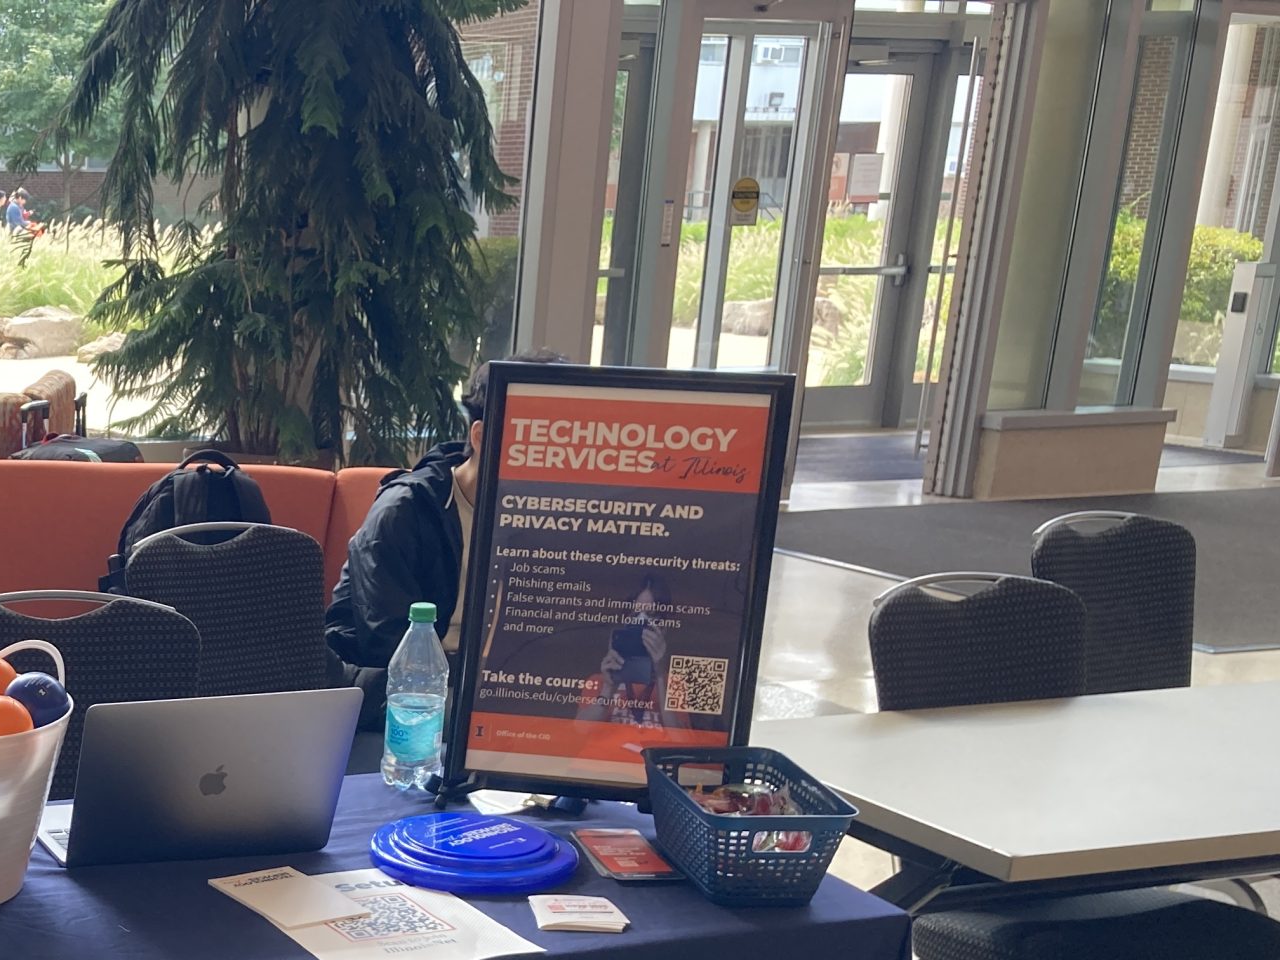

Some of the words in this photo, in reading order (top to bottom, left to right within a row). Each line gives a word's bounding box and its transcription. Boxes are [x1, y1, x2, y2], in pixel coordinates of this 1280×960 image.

[511, 417, 738, 452] TECHNOLOGY
[507, 444, 656, 474] SERVICES
[650, 456, 675, 473] at
[679, 456, 748, 484] Illinois
[501, 494, 657, 517] CYBERSECURITY
[660, 504, 704, 520] AND
[499, 513, 583, 531] PRIVACY
[587, 519, 670, 538] MATTER.
[496, 545, 529, 558] Learn
[532, 547, 567, 560] about
[570, 550, 603, 563] these
[606, 552, 689, 571] cybersecurity
[692, 558, 740, 572] threats:
[510, 562, 530, 573] Job
[532, 565, 566, 575] scams
[508, 576, 554, 592] Phishing
[556, 580, 591, 592] emails
[506, 591, 534, 604] False
[536, 595, 582, 607] warrants
[584, 597, 605, 608] and
[607, 598, 674, 613] immigration
[675, 604, 711, 616] scams
[503, 622, 524, 632] and
[526, 624, 554, 634] more
[505, 606, 553, 619] Financial
[555, 610, 575, 620] and
[577, 612, 619, 624] student
[621, 614, 645, 625] loan
[647, 618, 681, 629] scams
[481, 669, 515, 684] Take
[518, 672, 543, 686] the
[545, 675, 600, 691] course:
[479, 687, 654, 710] go.illinois.edu/cybersecurityetext
[335, 880, 404, 892] Setu
